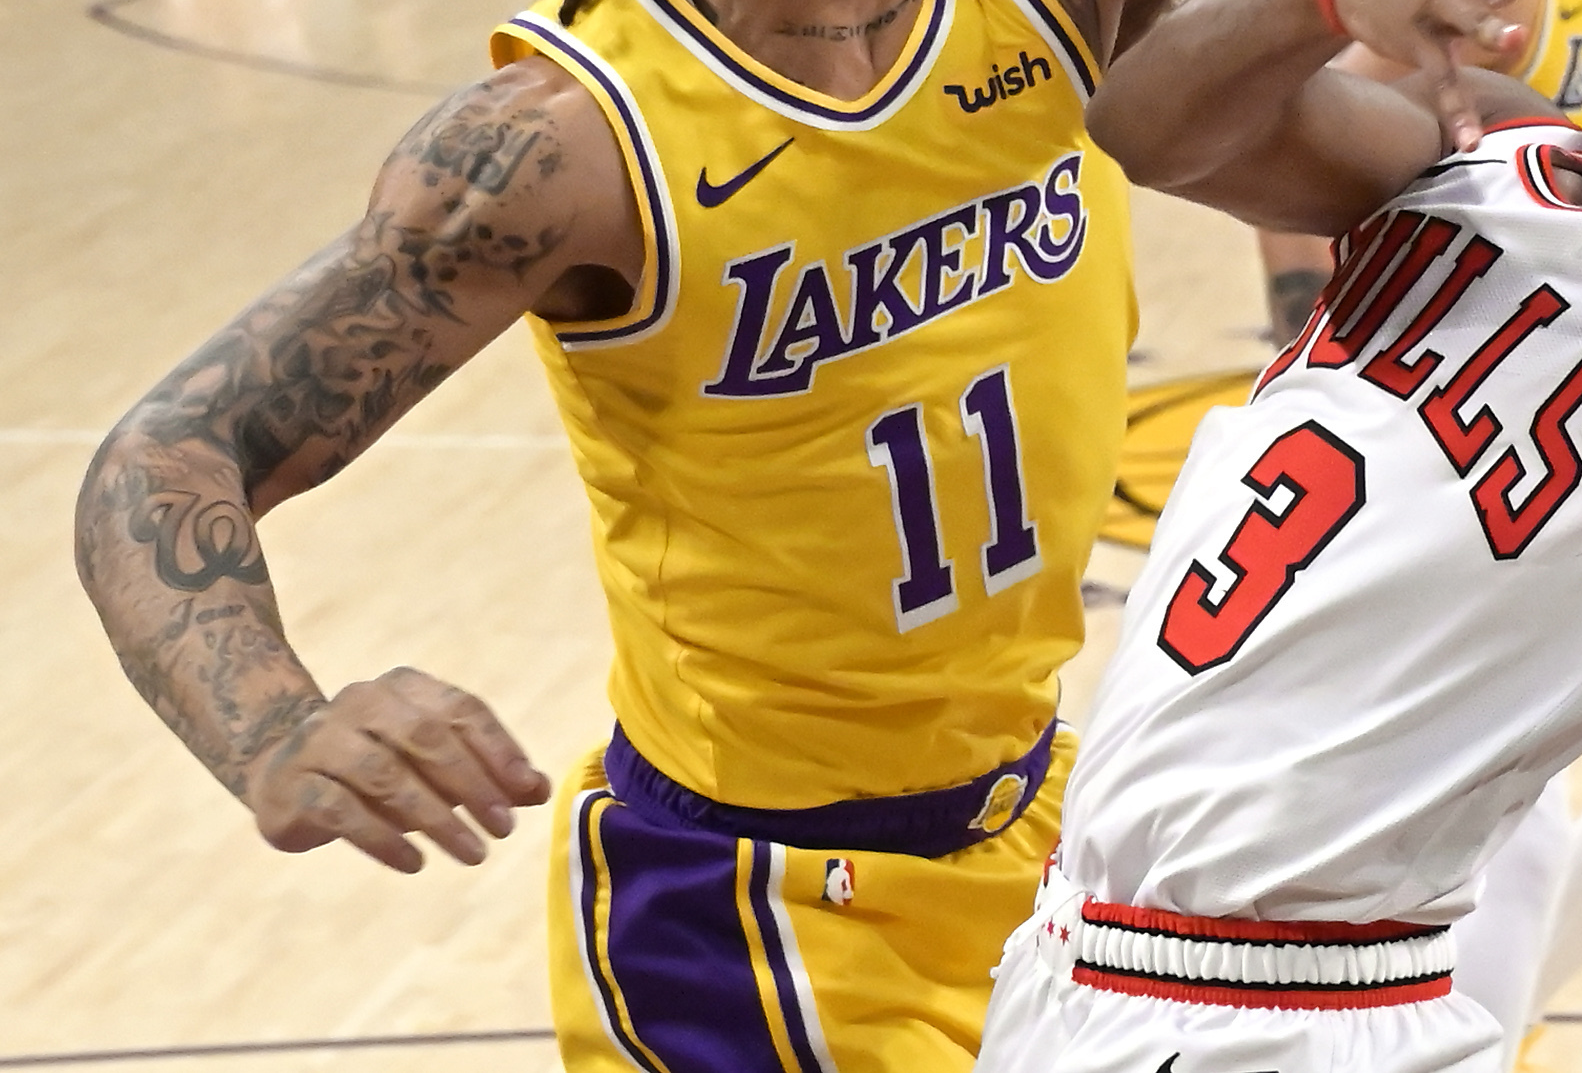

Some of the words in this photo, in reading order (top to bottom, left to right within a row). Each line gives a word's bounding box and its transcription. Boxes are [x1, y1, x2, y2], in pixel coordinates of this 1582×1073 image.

[944, 50, 1052, 114] wish
[700, 150, 1090, 400] LAKERS
[866, 362, 1043, 635] 11
[1156, 419, 1367, 676] 3
